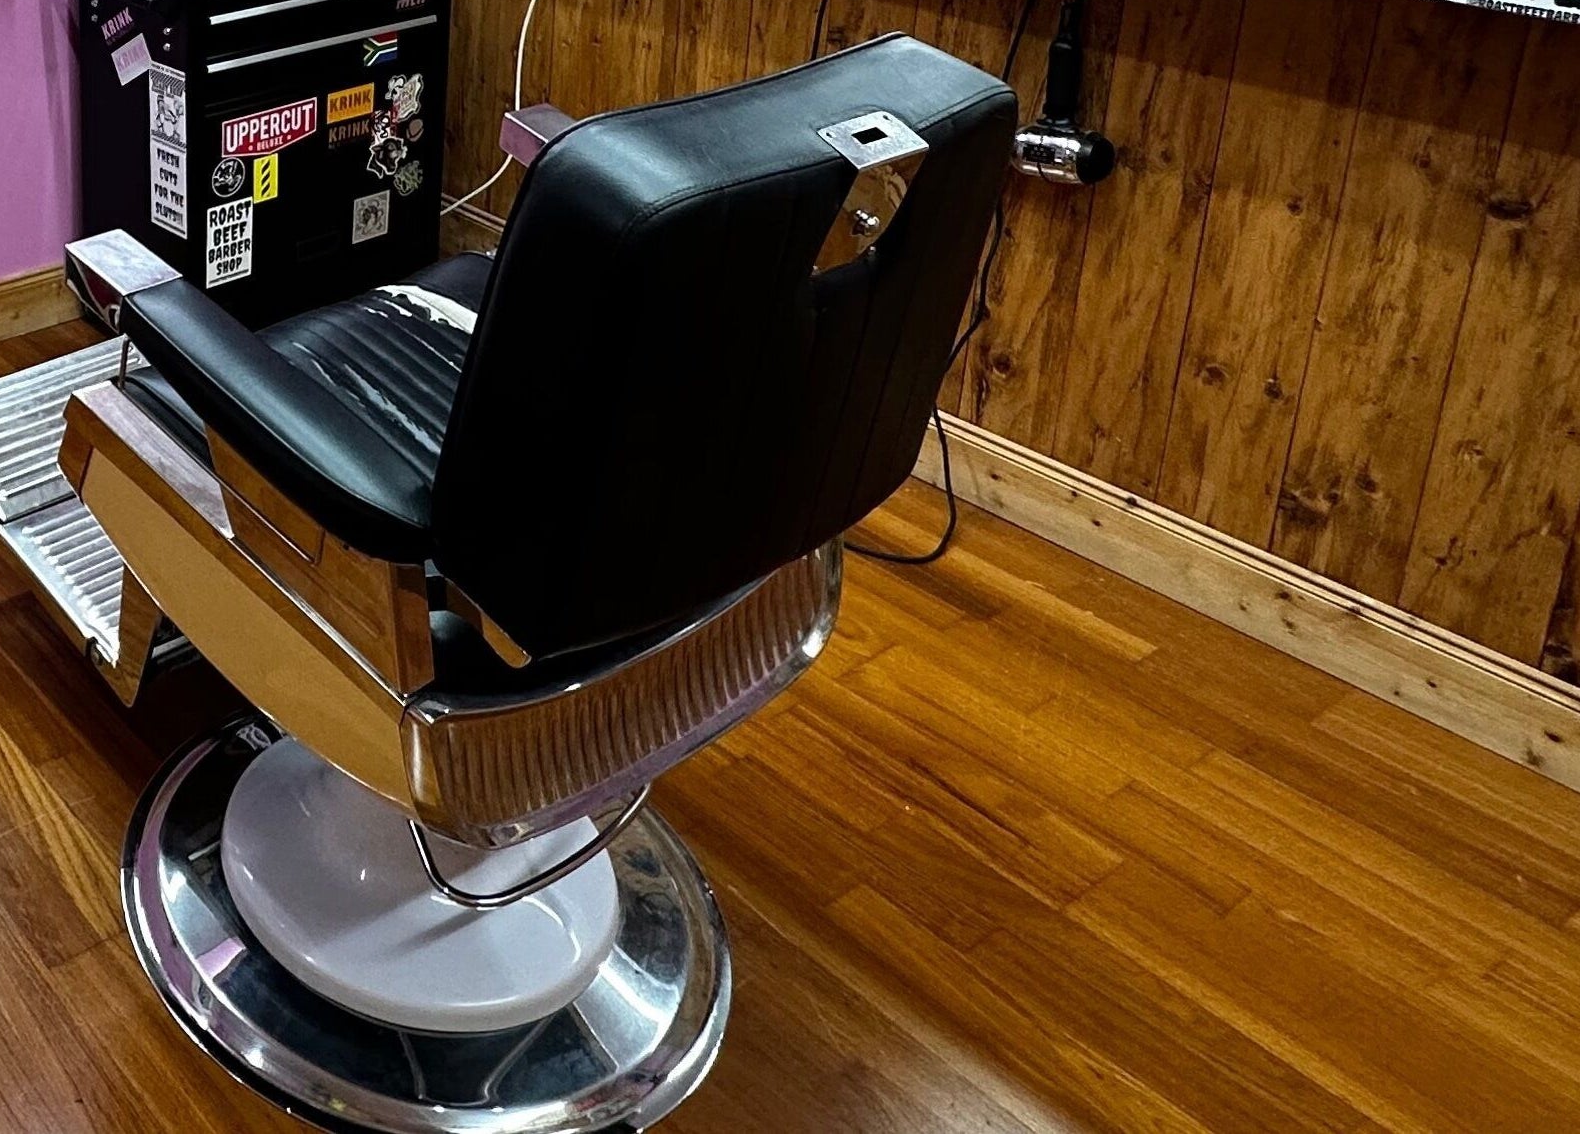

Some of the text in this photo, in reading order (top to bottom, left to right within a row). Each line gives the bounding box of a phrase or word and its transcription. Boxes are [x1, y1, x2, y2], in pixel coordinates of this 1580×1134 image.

[101, 7, 133, 40] KRINK
[329, 89, 371, 114] KRINK
[226, 103, 314, 153] UPPERCUT
[329, 119, 370, 143] KRINK
[154, 183, 168, 200] FOR
[210, 200, 251, 228] ROAST
[213, 222, 247, 247] BEEF
[209, 238, 251, 264] BARBER
[216, 254, 243, 275] SHOP
